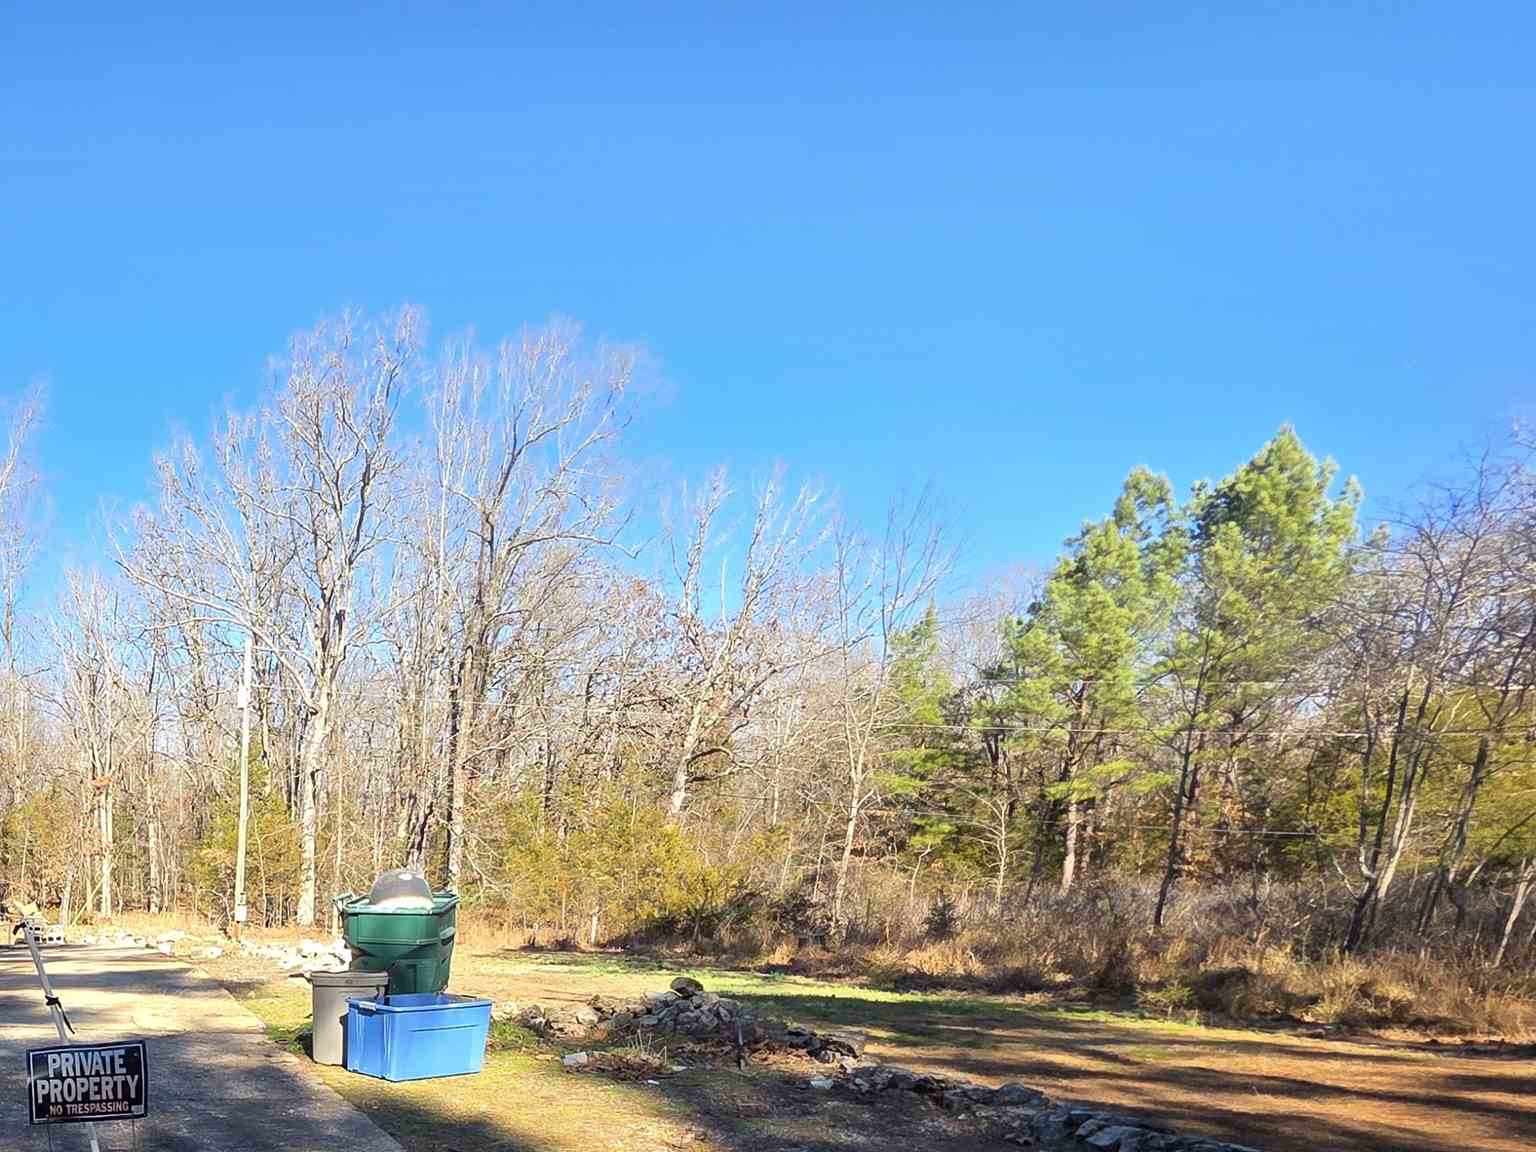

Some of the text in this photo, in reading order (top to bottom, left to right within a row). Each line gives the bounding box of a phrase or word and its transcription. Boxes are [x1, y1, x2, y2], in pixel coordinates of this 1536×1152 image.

[47, 1049, 127, 1078] PRIVATE
[36, 1074, 139, 1104] PROPERTY
[49, 1101, 129, 1116] NO TRESPASSING
